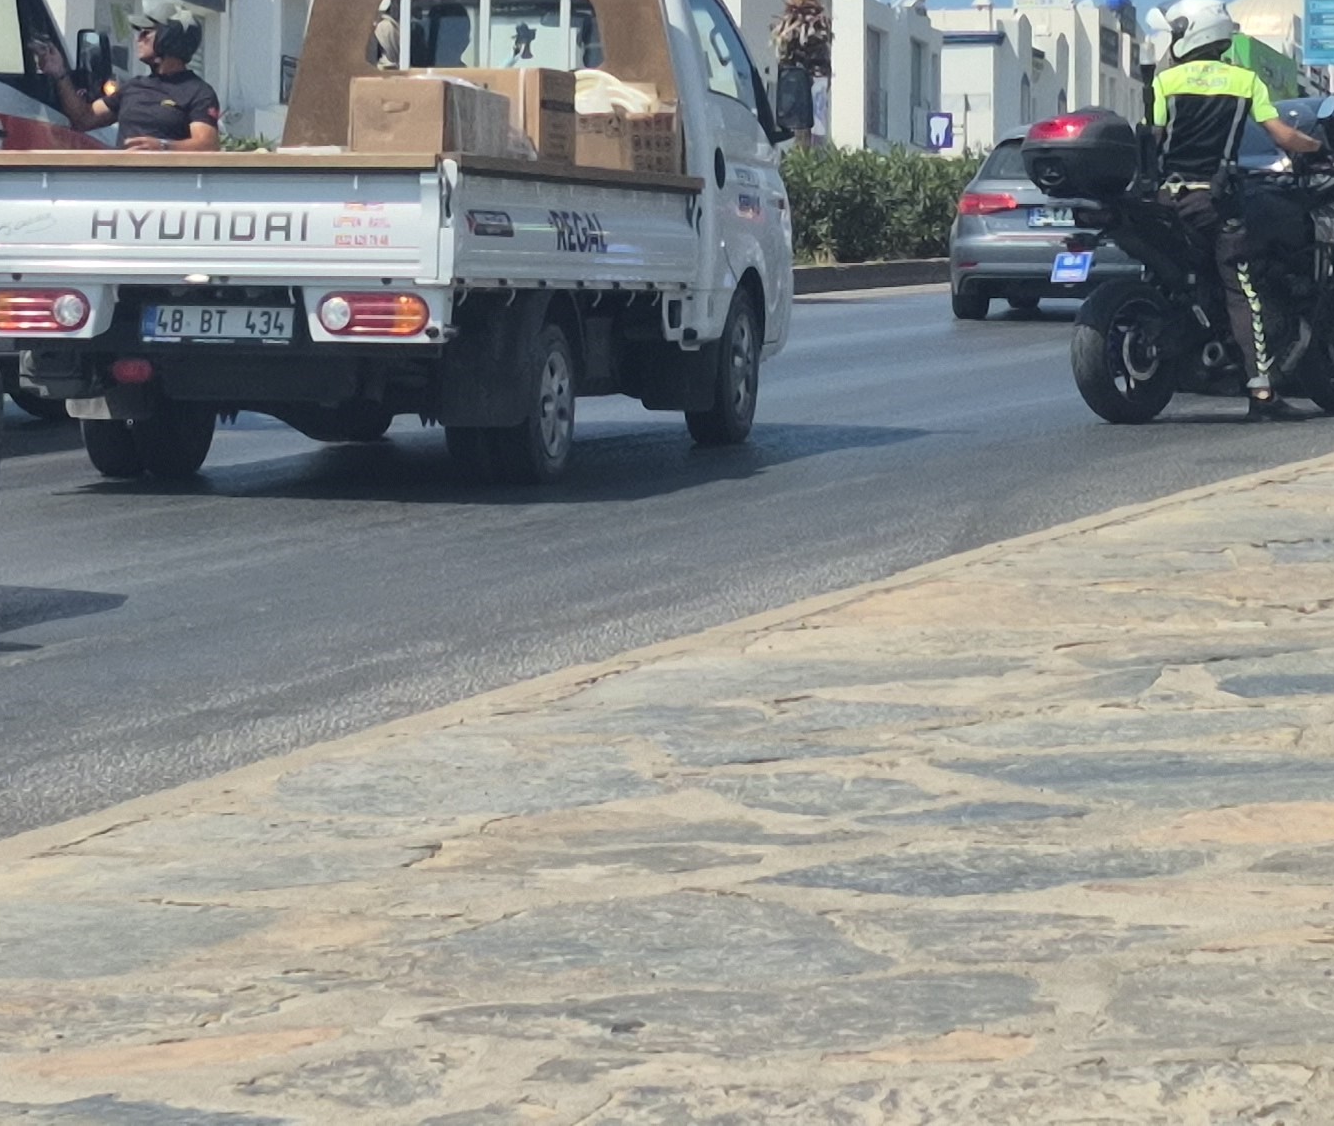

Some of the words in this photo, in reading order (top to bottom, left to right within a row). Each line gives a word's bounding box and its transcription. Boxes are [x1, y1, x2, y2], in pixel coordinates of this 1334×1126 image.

[91, 209, 309, 241] HYUNDAI
[549, 209, 608, 253] REGAL
[157, 308, 184, 333] 48
[200, 309, 227, 334] BT
[245, 310, 285, 335] 434
